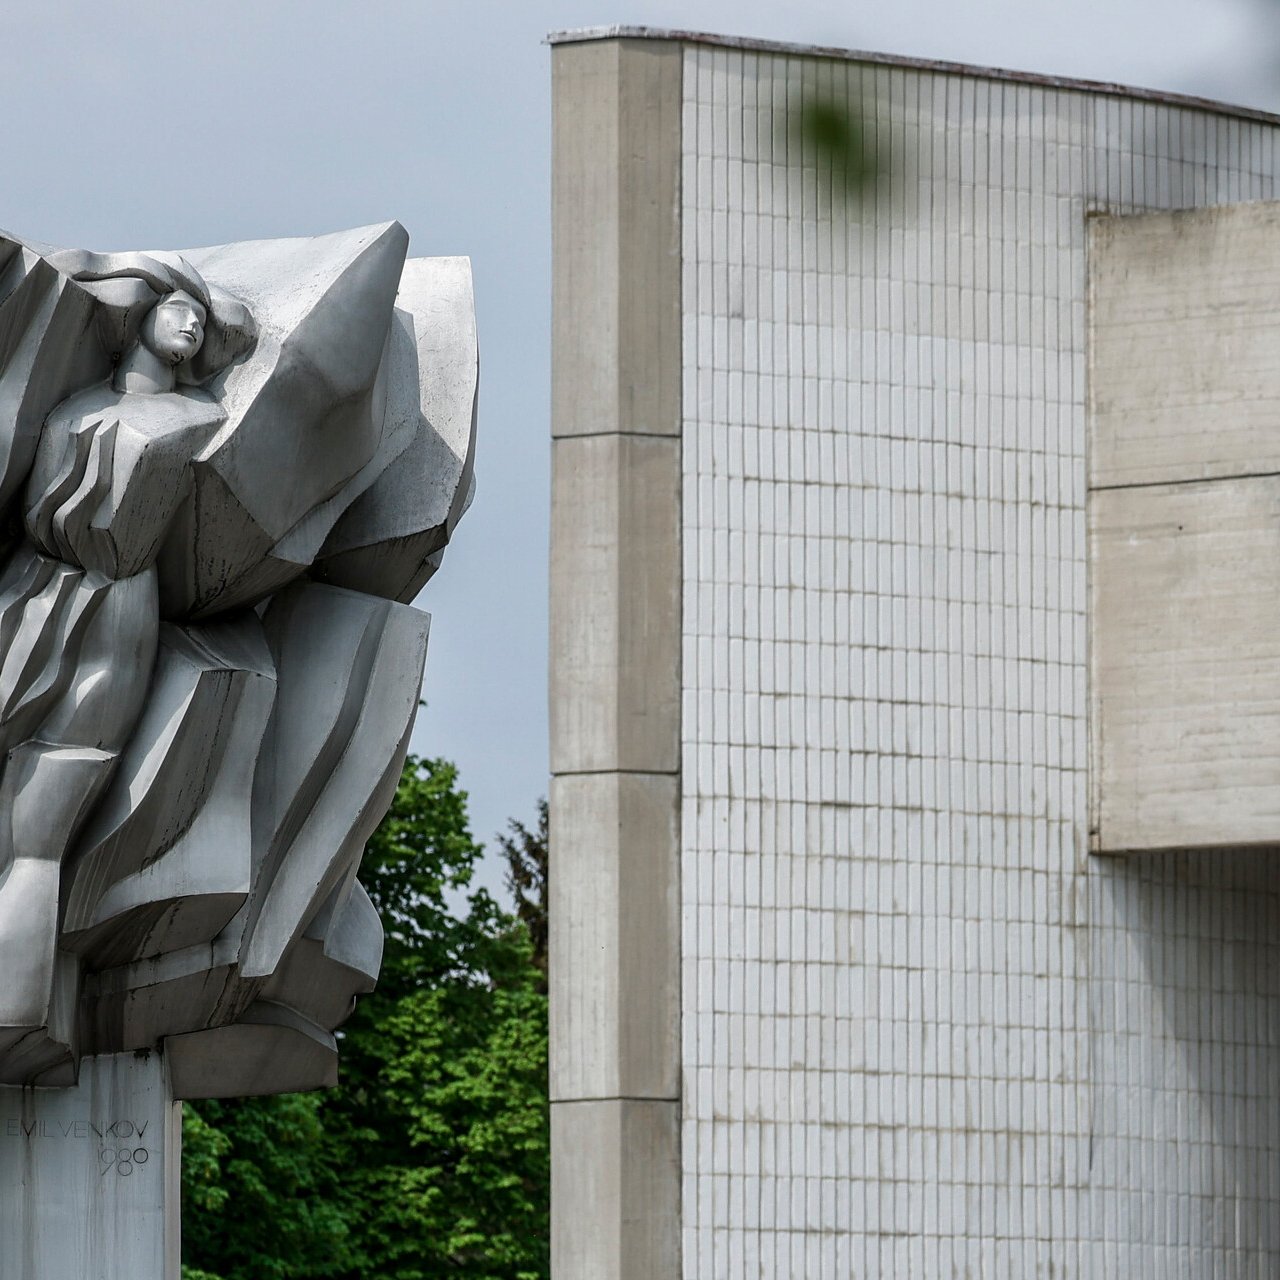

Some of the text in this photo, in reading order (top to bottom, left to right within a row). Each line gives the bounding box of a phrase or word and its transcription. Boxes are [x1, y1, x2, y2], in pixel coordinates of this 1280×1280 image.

[7, 1119, 148, 1138] EMIL VENKOV
[98, 1147, 148, 1176] 1980
